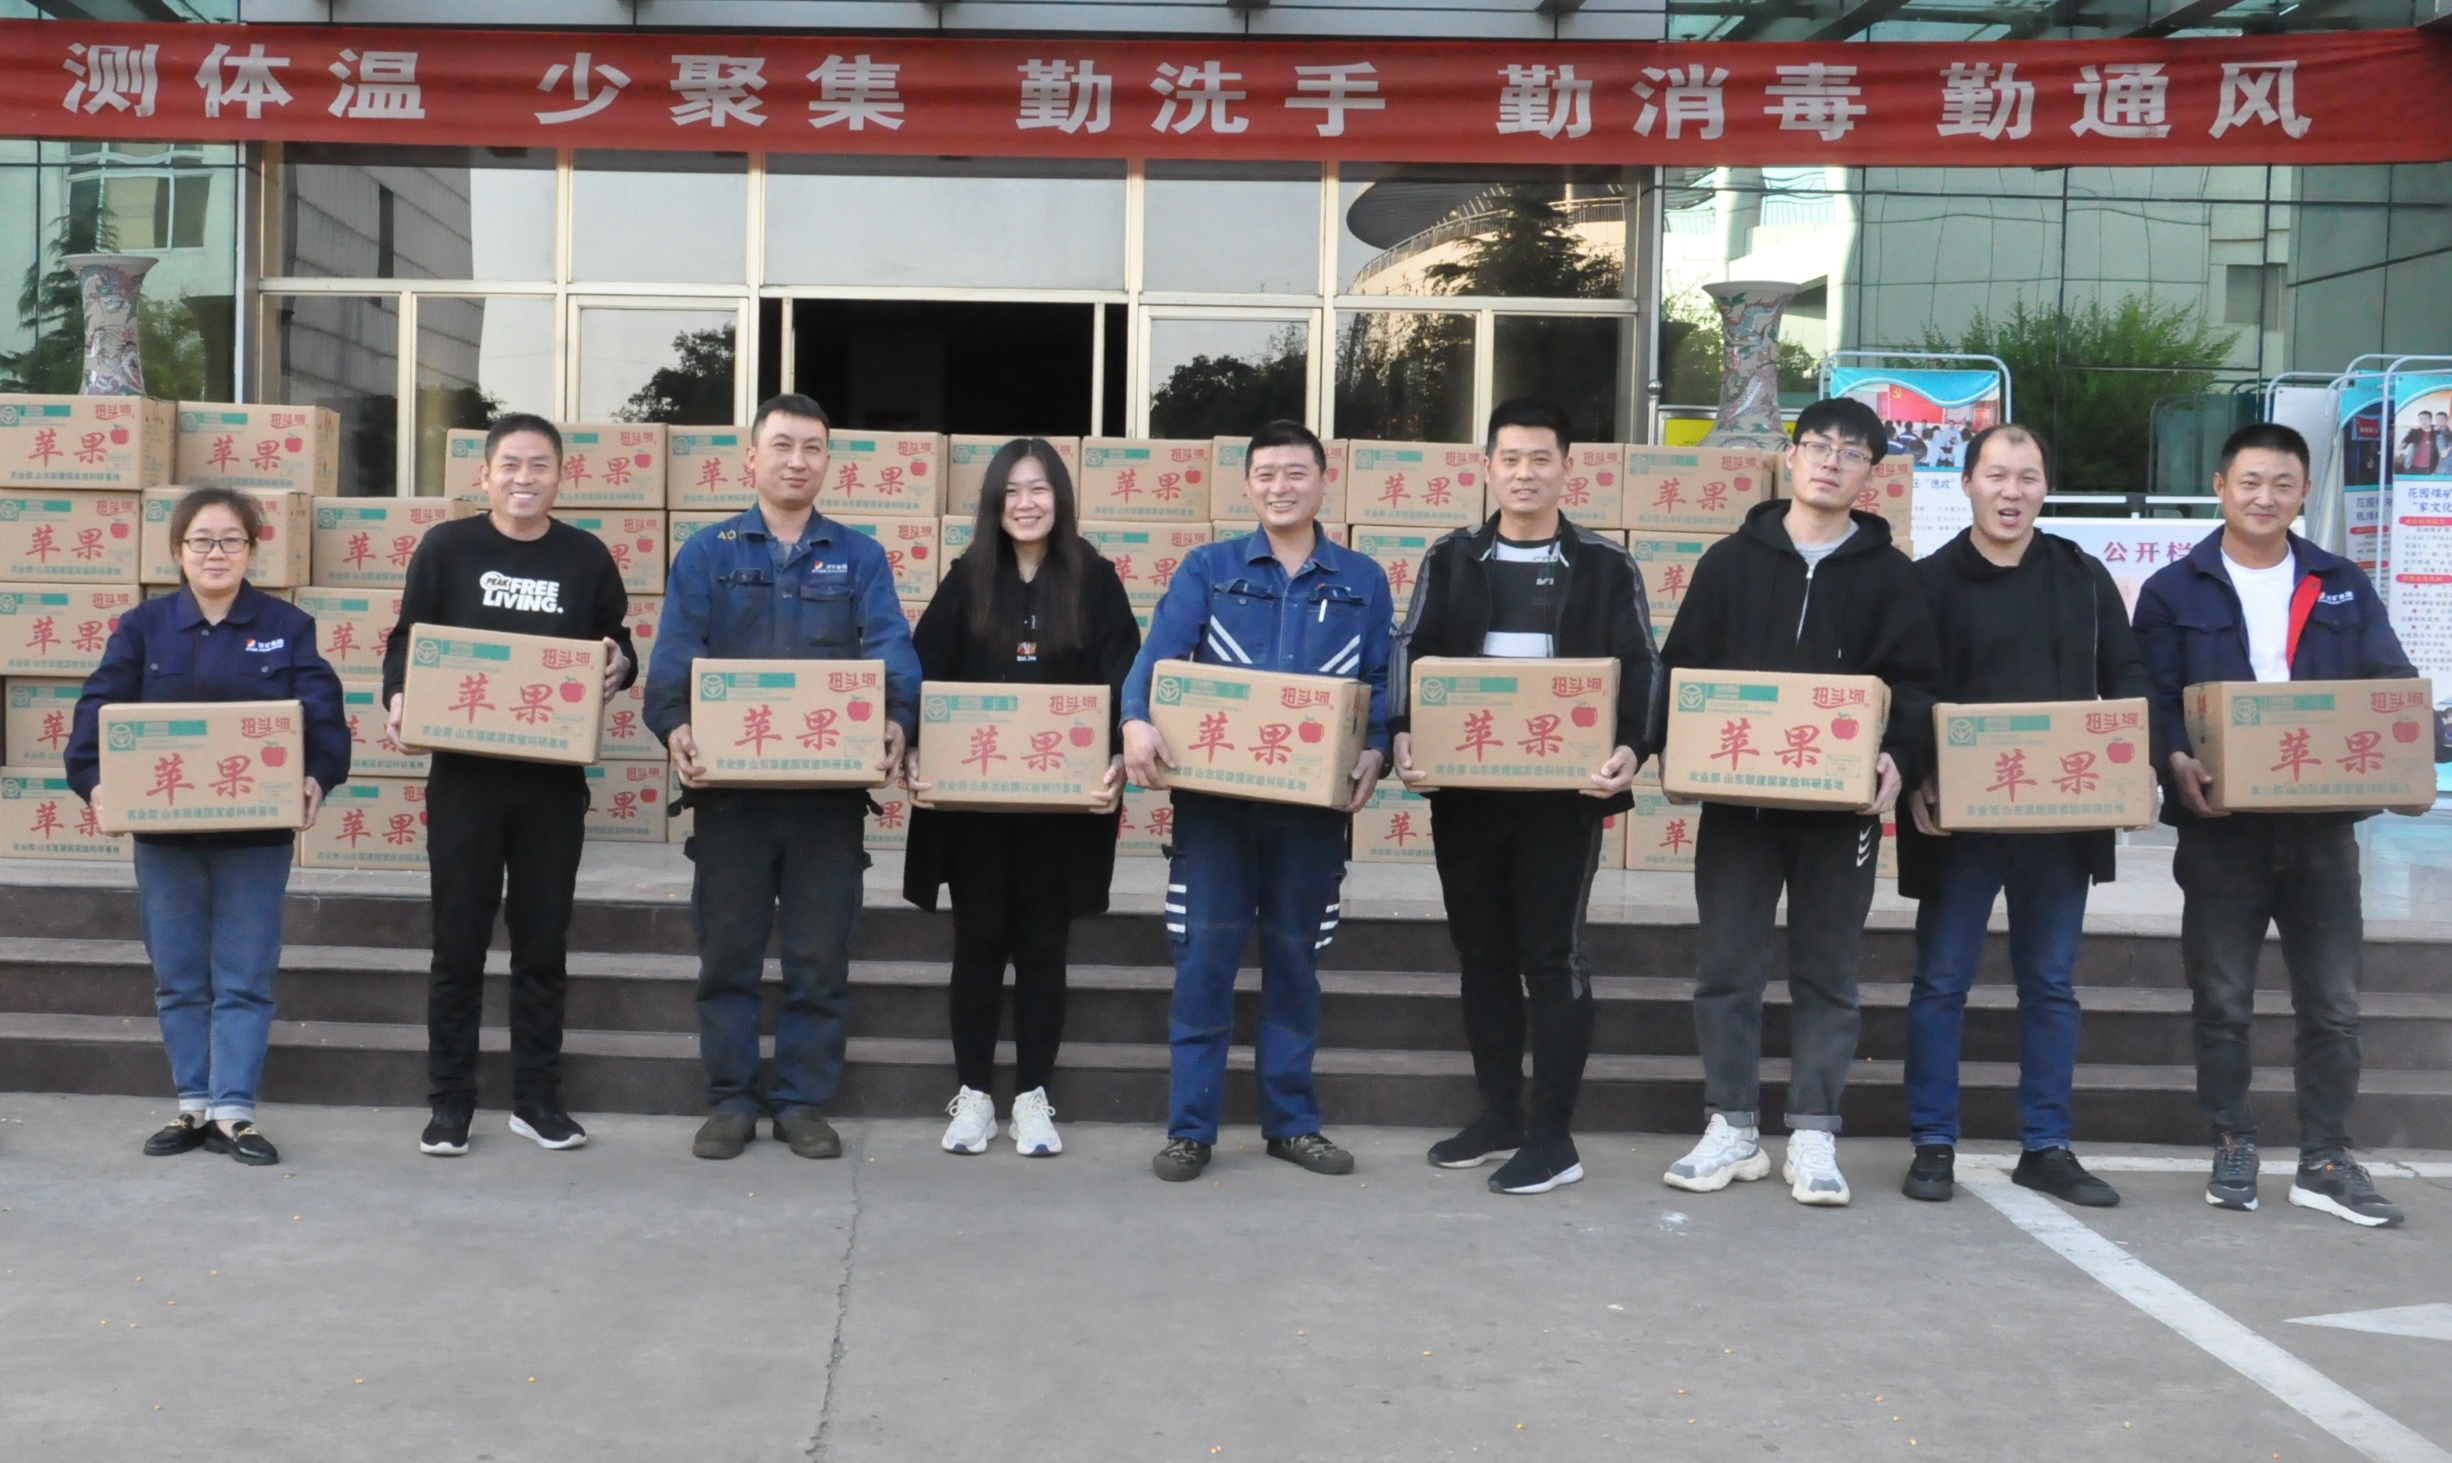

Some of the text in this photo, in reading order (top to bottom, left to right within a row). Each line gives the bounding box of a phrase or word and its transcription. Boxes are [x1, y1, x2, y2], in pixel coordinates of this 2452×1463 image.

[62, 41, 426, 121] 测体温
[534, 52, 906, 131] 少聚集
[1015, 58, 1387, 138] 勤洗手
[27, 427, 108, 468] 苹果
[207, 435, 280, 473] 苹果
[833, 463, 905, 498] 苹果
[1111, 469, 1181, 504] 苹果
[1378, 473, 1451, 508] 苹果
[1653, 478, 1728, 514] 苹果
[25, 525, 105, 565] 苹果
[482, 589, 564, 614] LIVING.
[486, 577, 560, 598] PEAK FREE
[26, 616, 104, 655] 苹果
[448, 672, 553, 725] 苹果
[735, 705, 840, 756] 苹果
[961, 725, 1065, 775] 苹果
[1188, 711, 1292, 765] 苹果
[1455, 709, 1564, 762] 苹果
[1710, 718, 1822, 771] 苹果
[1986, 748, 2100, 802] 苹果
[2271, 728, 2384, 782] 苹果
[146, 753, 254, 806] 苹果
[1690, 771, 1721, 783] 农业部
[336, 809, 416, 848] 苹果
